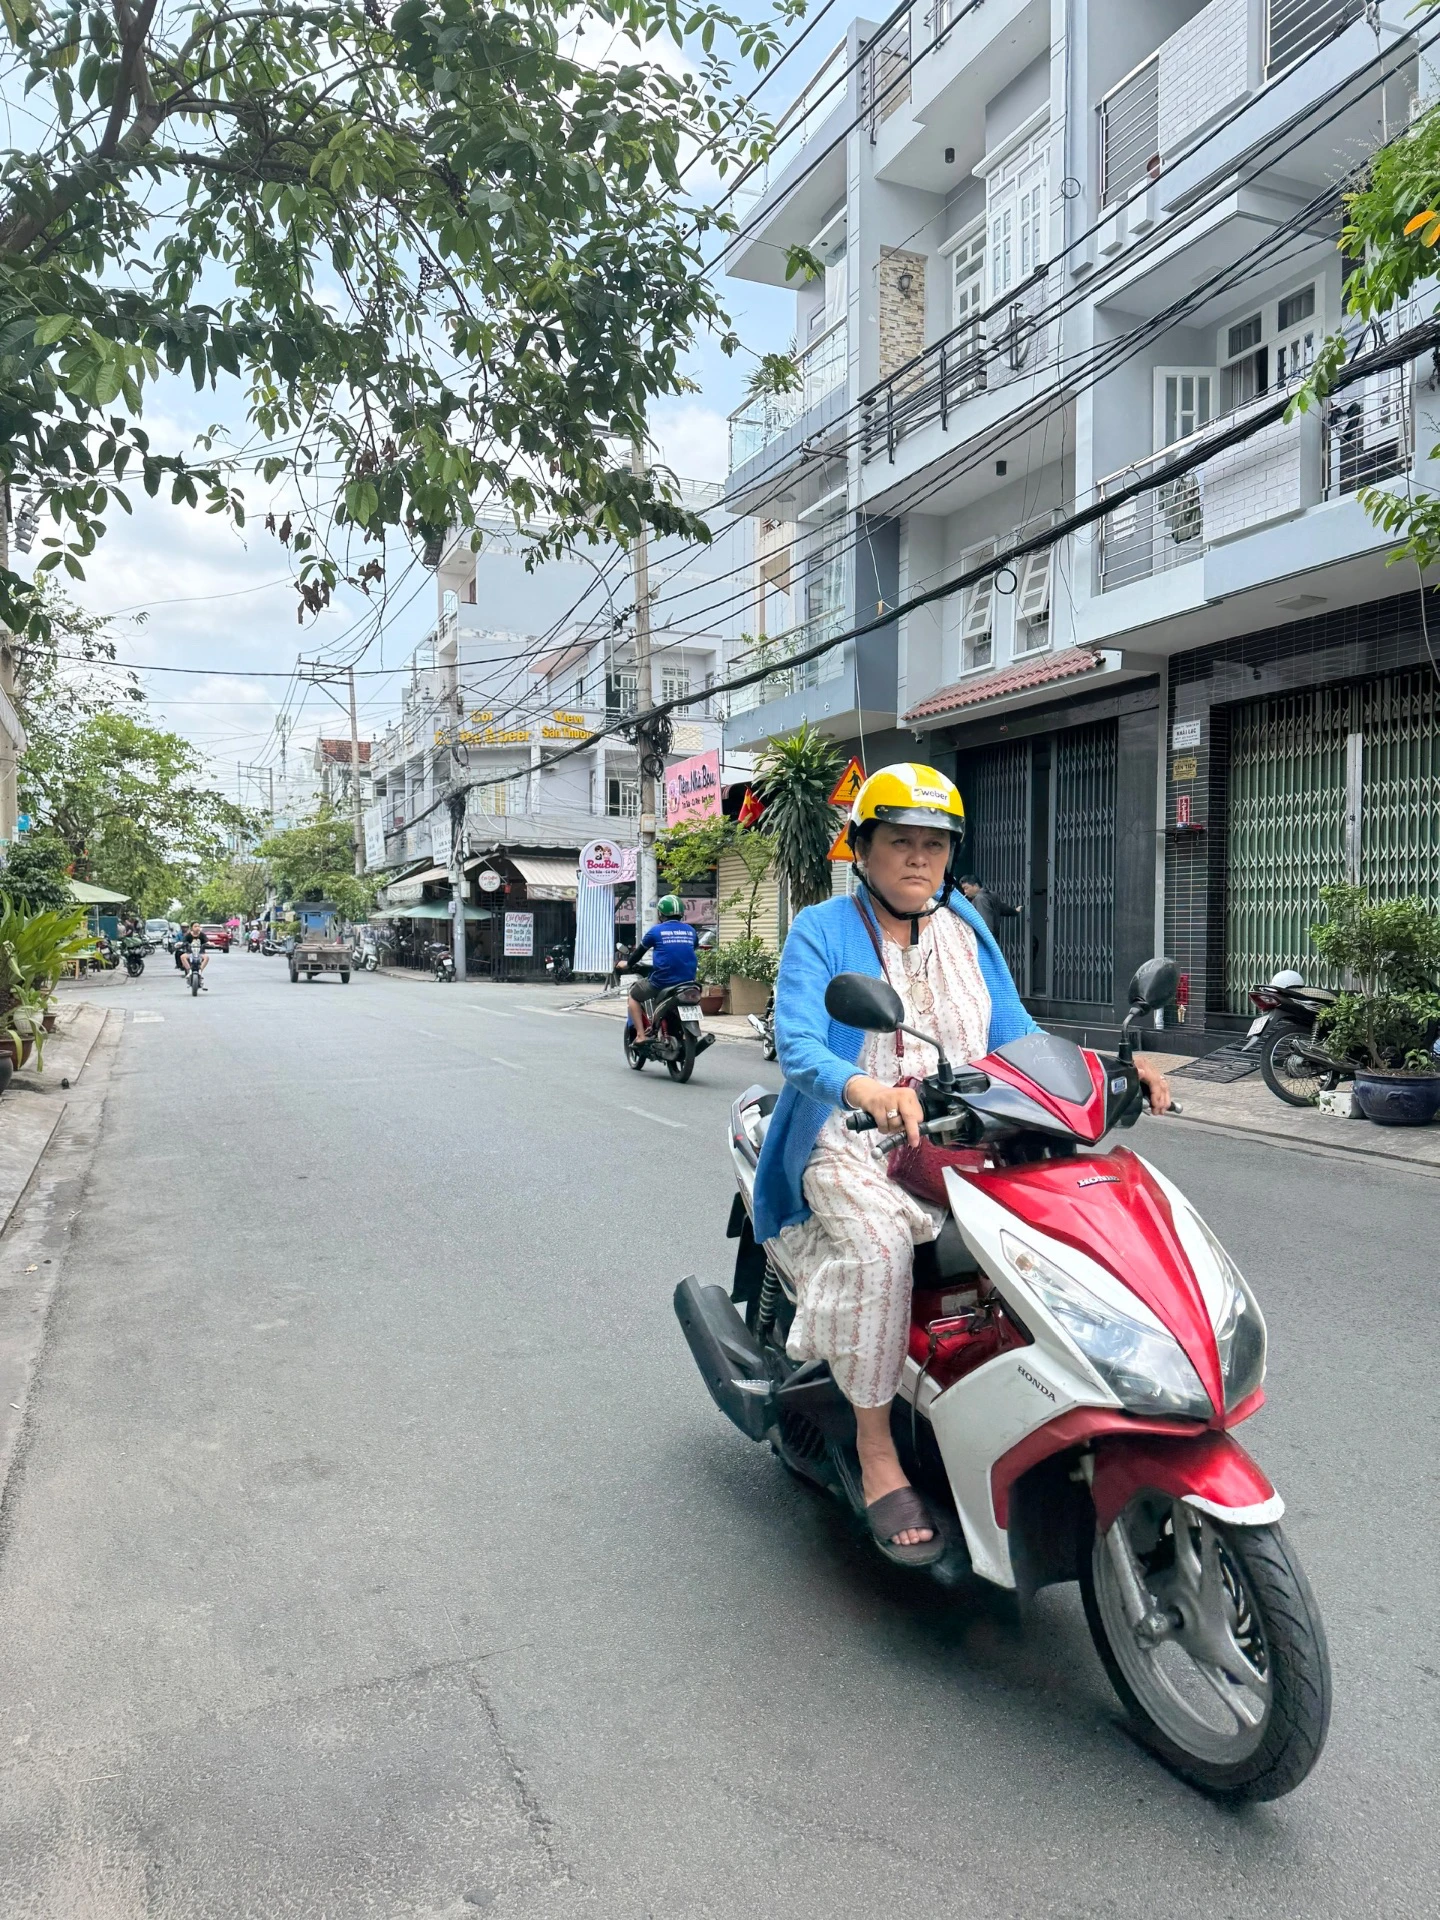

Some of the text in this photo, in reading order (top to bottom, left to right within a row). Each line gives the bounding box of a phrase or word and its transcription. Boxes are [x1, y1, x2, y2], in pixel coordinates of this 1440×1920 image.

[553, 710, 585, 724] View
[921, 790, 948, 801] weber
[586, 859, 620, 869] BouBin
[1017, 1364, 1056, 1403] HONDA
